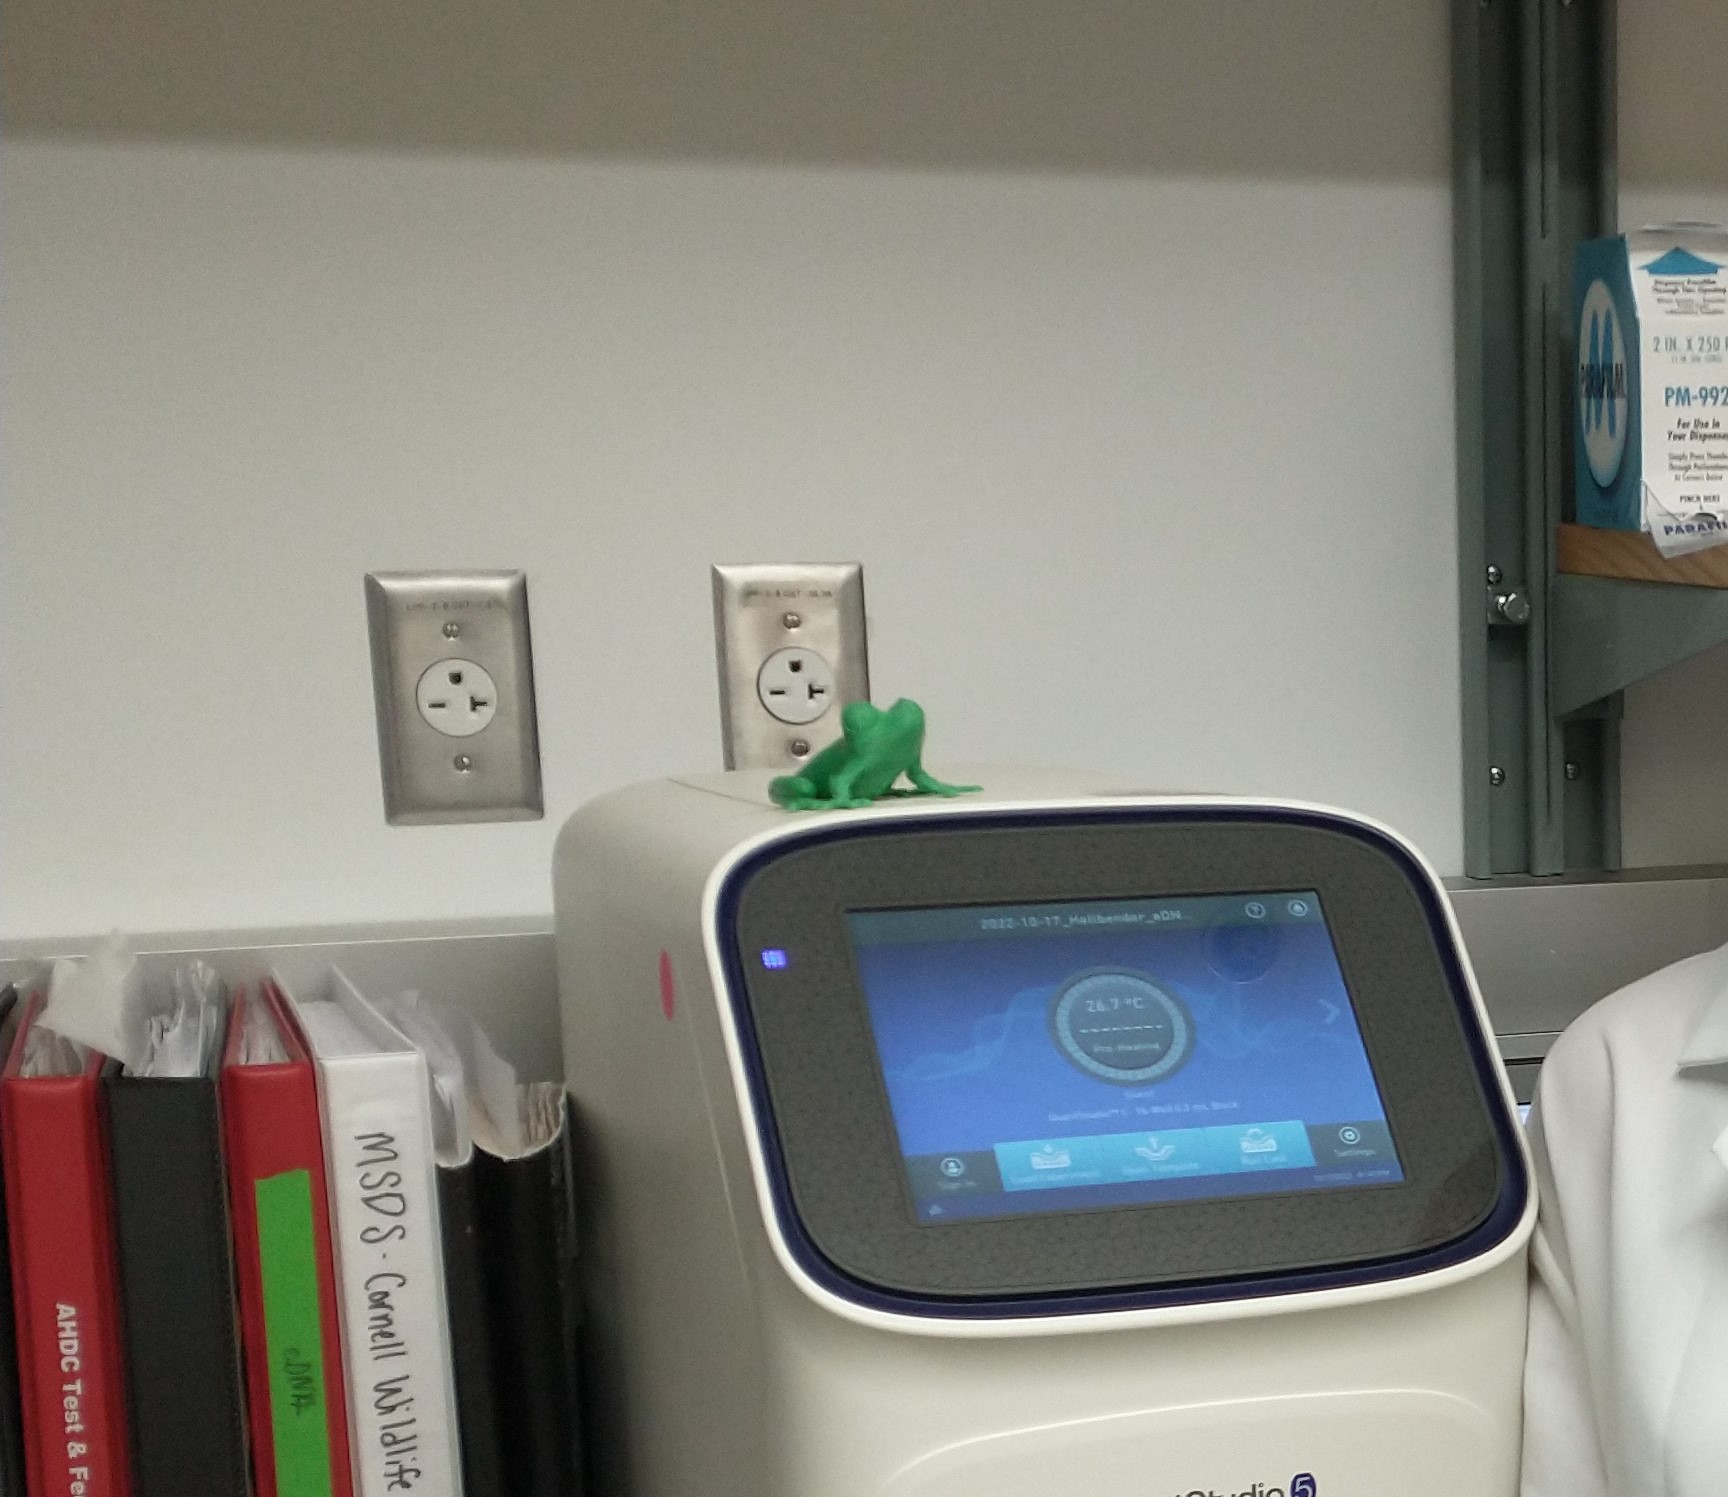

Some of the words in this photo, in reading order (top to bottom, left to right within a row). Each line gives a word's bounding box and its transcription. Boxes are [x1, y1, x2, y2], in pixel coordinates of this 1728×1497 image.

[1653, 336, 1661, 353] 2
[1698, 335, 1721, 353] 250
[354, 1132, 407, 1245] MSDS
[56, 1302, 81, 1373] AHDC
[364, 1272, 408, 1361] Cornell
[62, 1378, 85, 1435] Test
[373, 1374, 422, 1492] Wildlife
[66, 1441, 88, 1460] &
